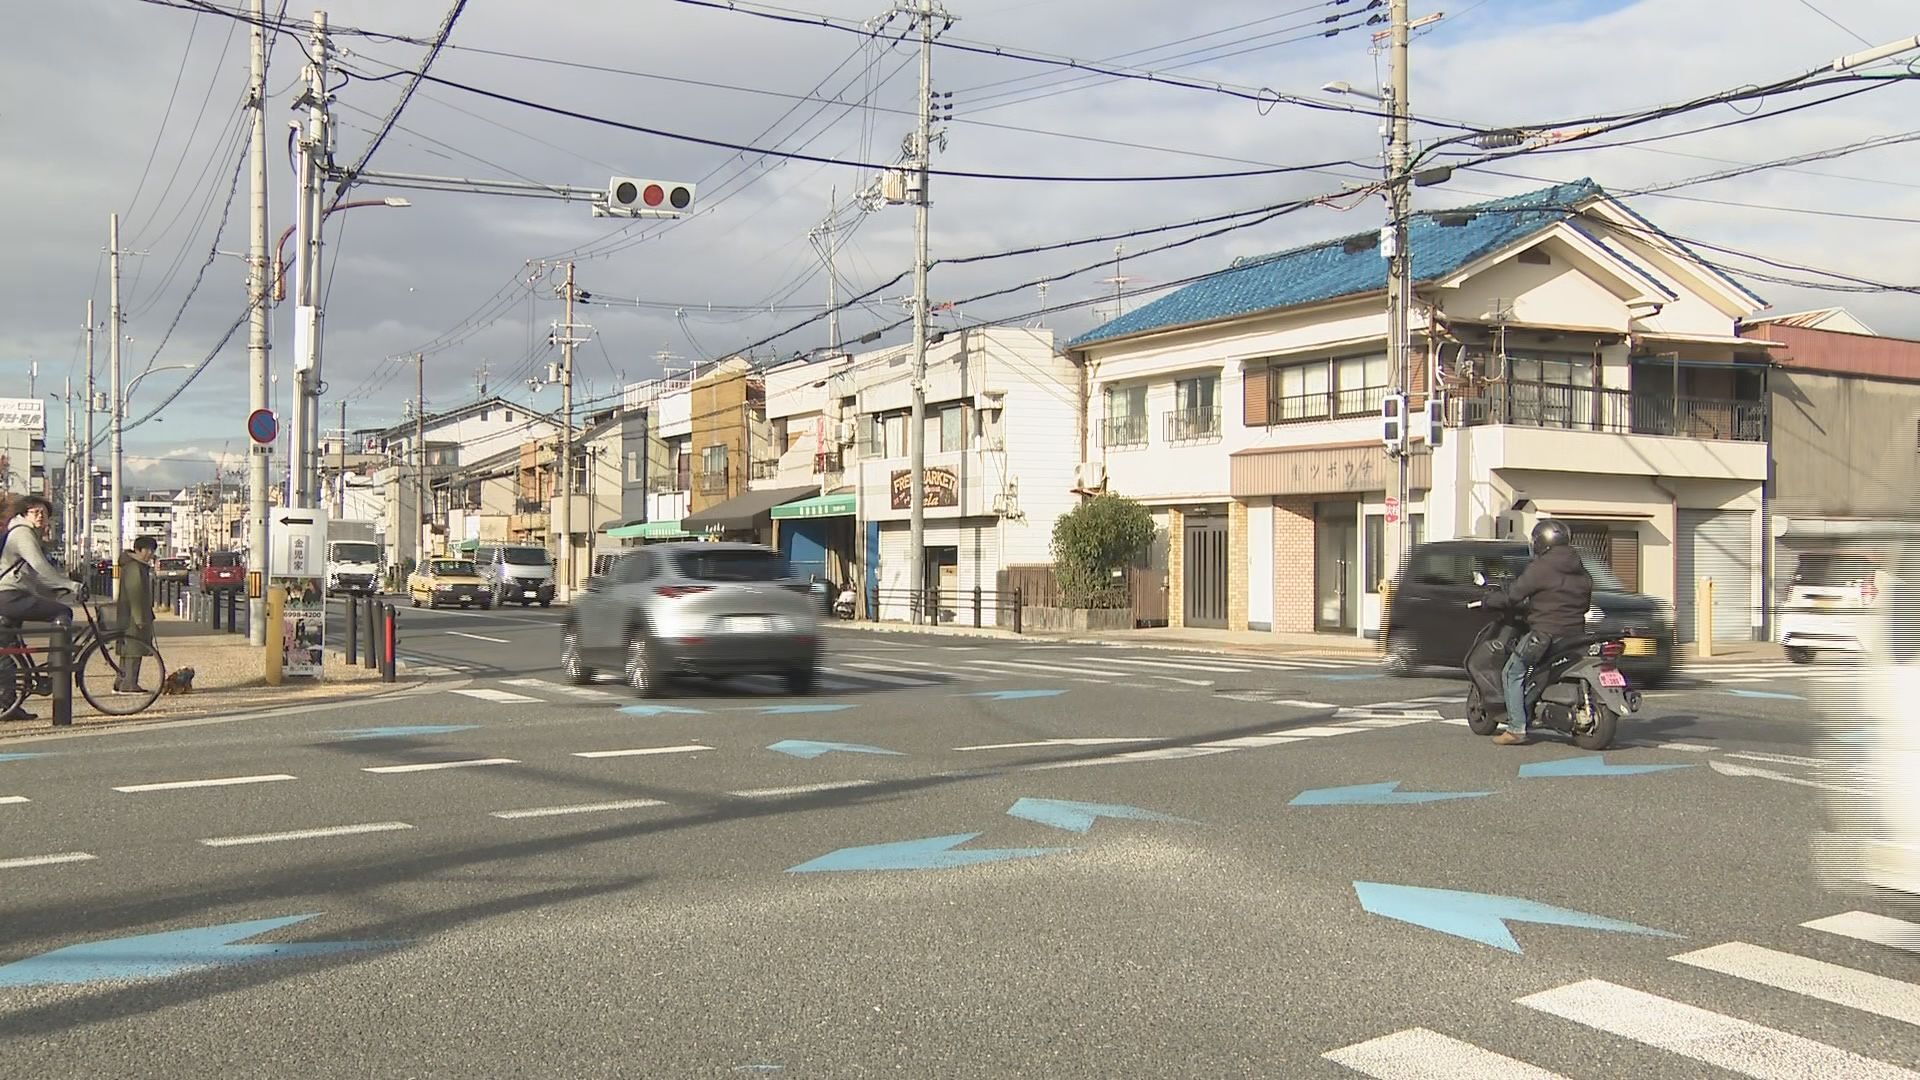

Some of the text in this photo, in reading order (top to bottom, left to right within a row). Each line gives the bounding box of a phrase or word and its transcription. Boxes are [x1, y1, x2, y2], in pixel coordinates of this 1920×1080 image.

[893, 473, 913, 494] FRE
[293, 538, 304, 571] 金児家
